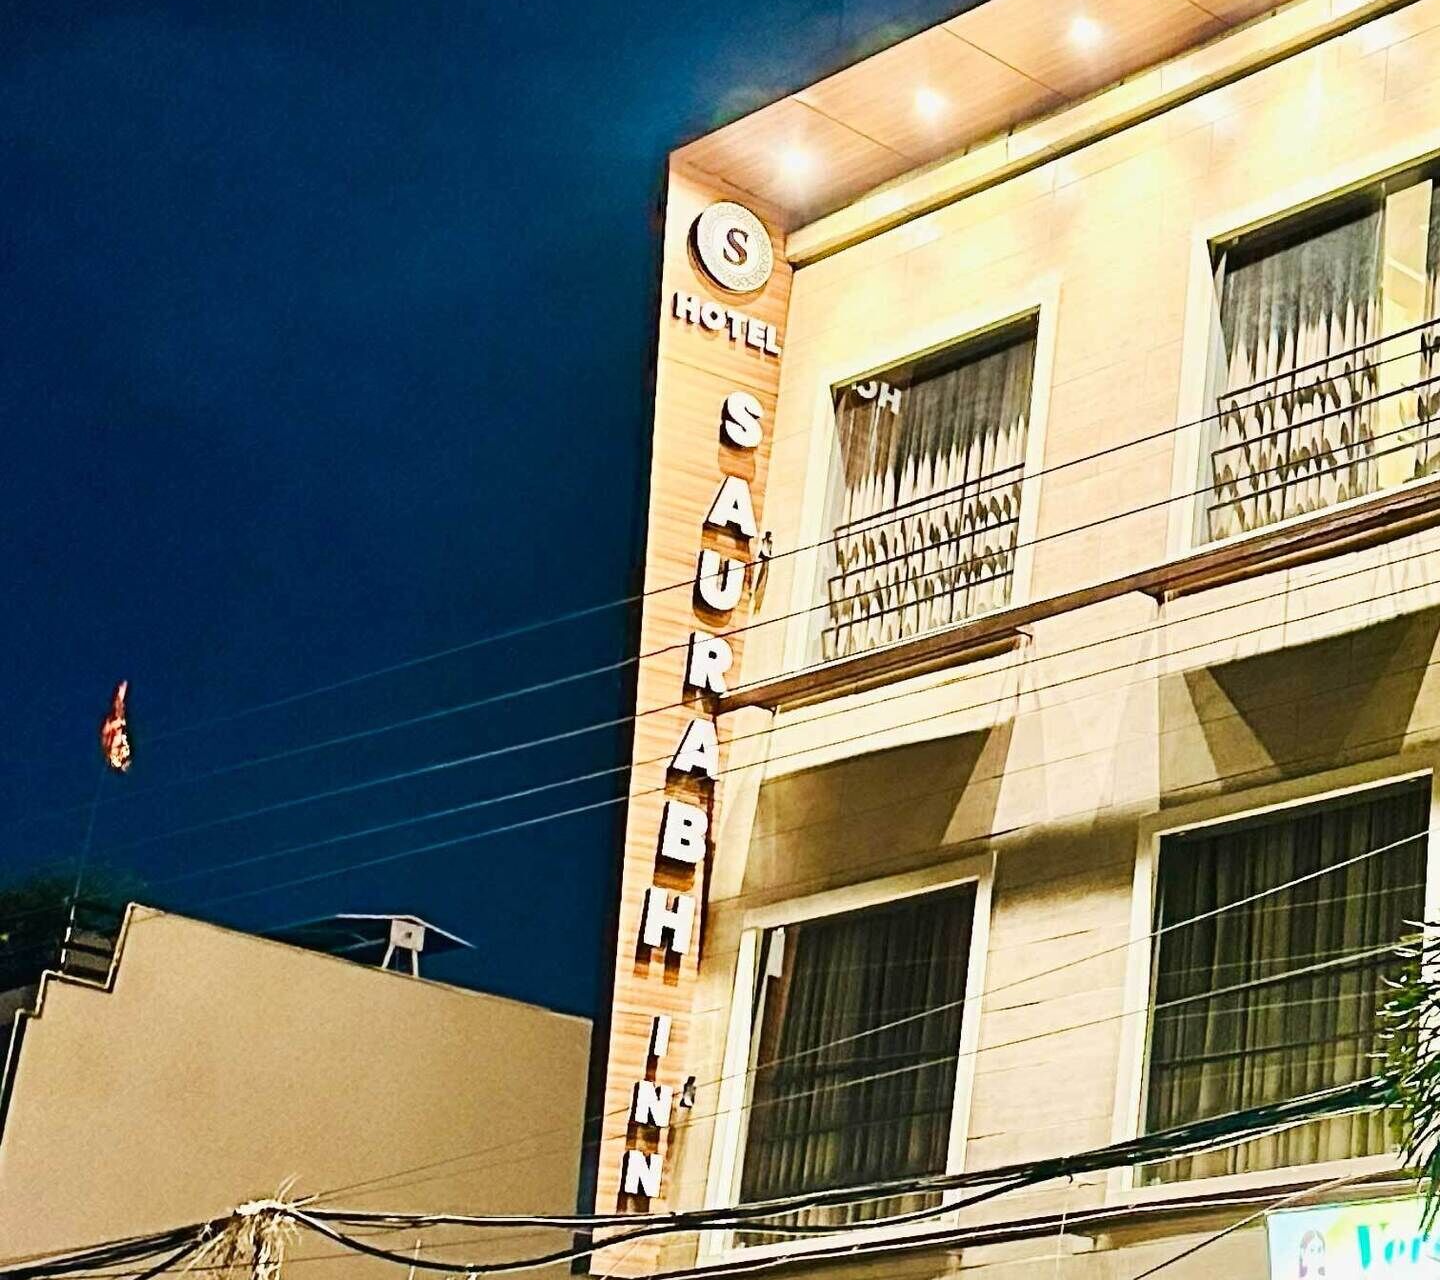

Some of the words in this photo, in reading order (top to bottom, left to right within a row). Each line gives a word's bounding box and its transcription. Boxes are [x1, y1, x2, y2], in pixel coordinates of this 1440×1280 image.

[723, 227, 749, 266] S
[672, 290, 783, 358] HOTEL
[640, 390, 764, 957] SAURABH
[622, 1014, 673, 1199] INN
